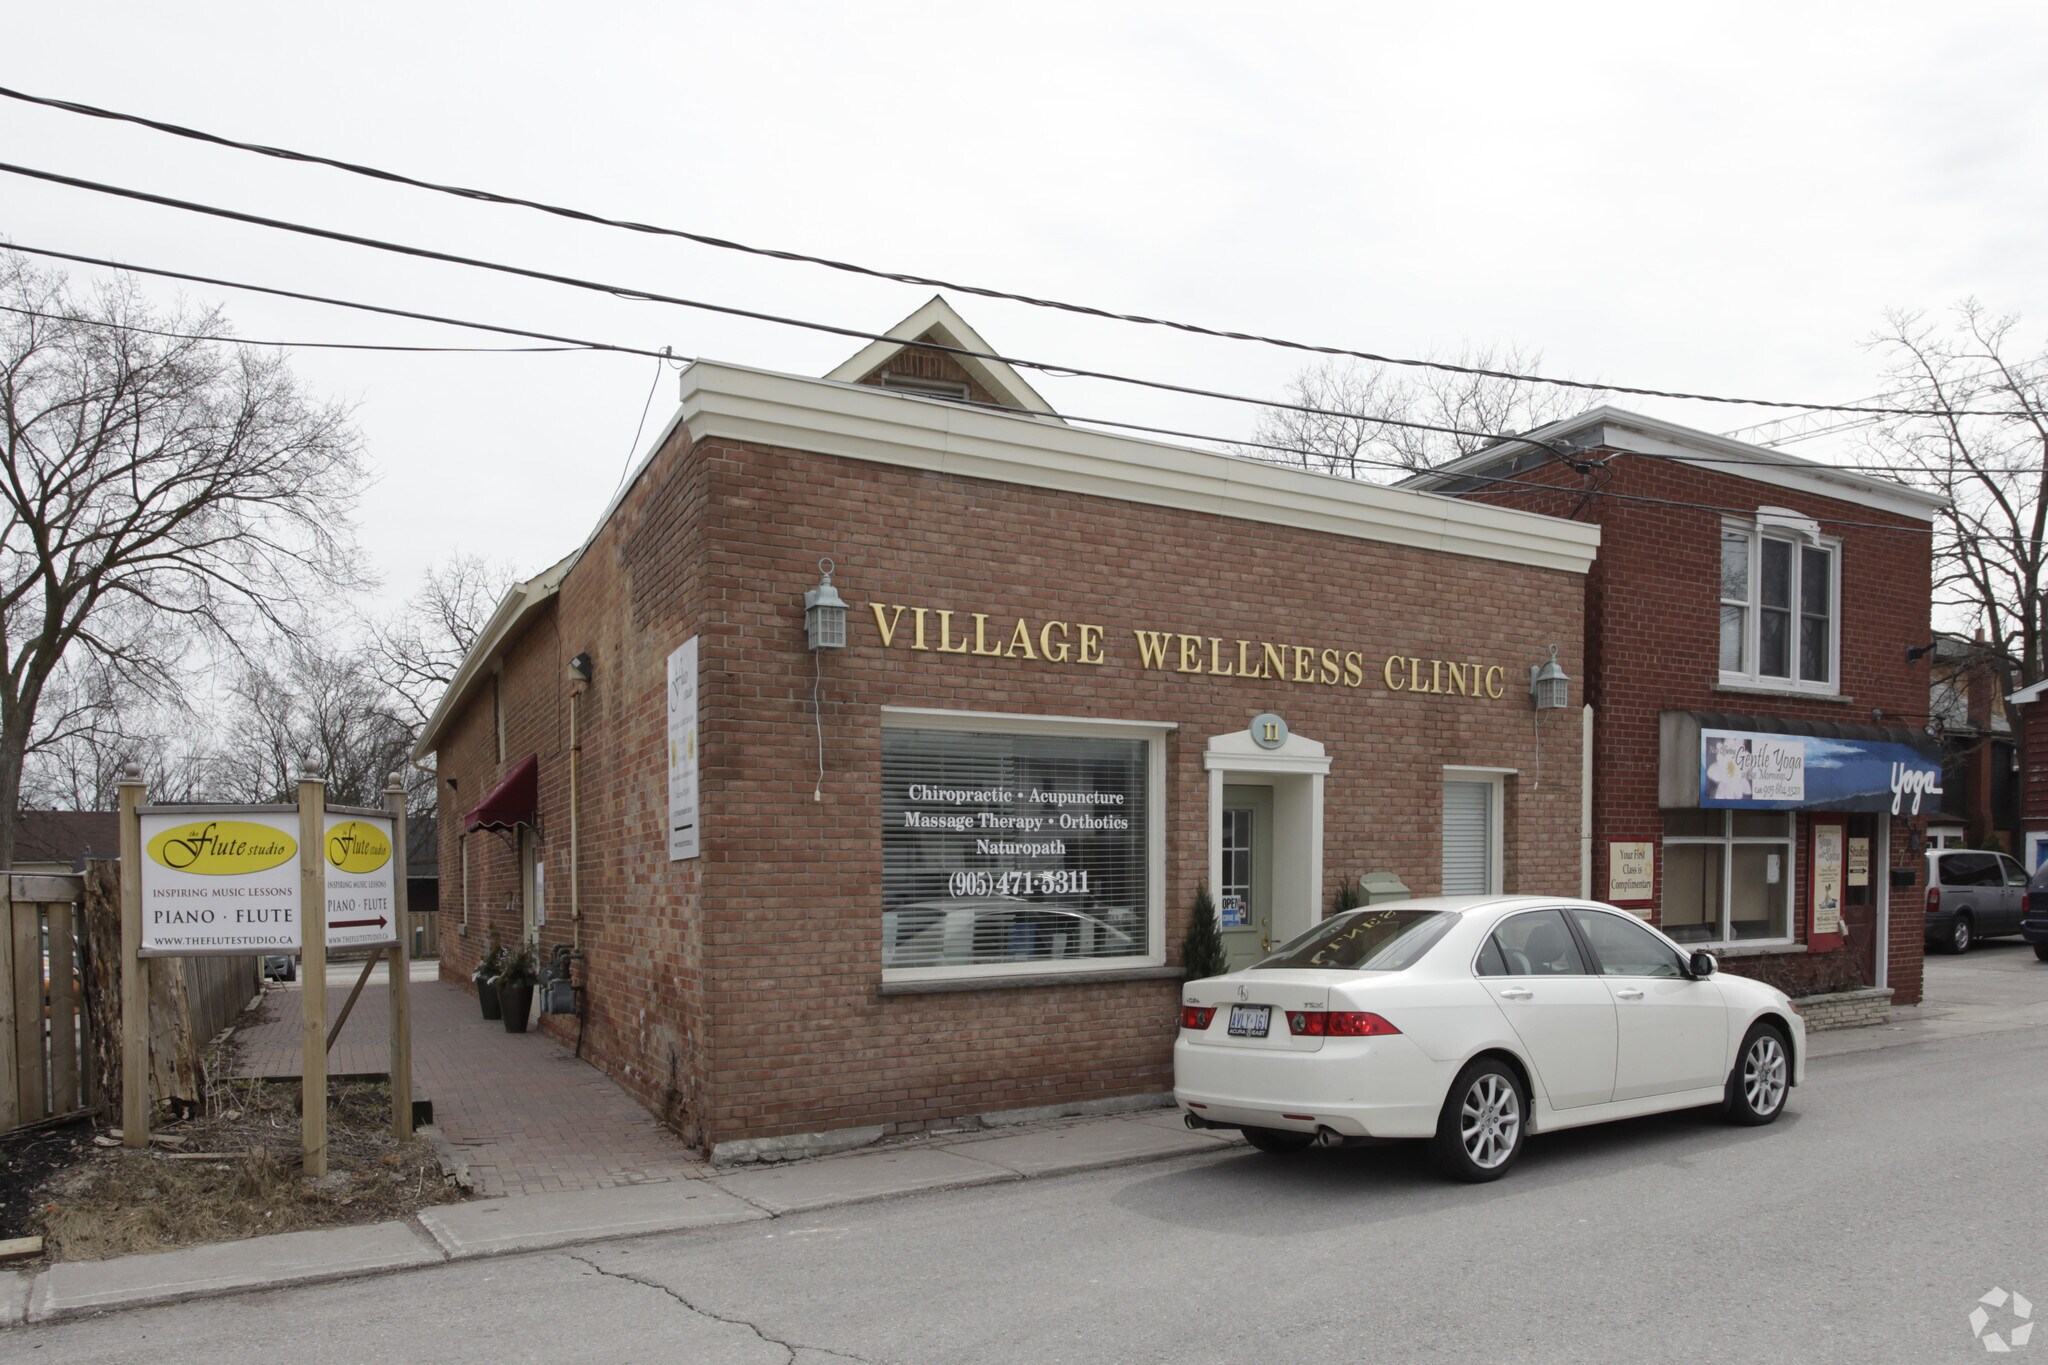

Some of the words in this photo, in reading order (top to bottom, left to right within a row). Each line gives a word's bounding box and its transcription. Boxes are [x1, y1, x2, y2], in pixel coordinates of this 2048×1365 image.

[868, 602, 1105, 665] VILLAGE
[1133, 630, 1363, 687] WELLNESS
[1384, 655, 1505, 699] CLINIC
[1263, 722, 1280, 742] 11
[1735, 743, 1769, 771] Gentle
[1773, 748, 1802, 781] Yoga
[909, 784, 1012, 805] Chiropractic
[1029, 788, 1124, 807] Acupuncture
[904, 812, 974, 831] Massage
[978, 813, 1043, 831] Therapy
[1059, 814, 1128, 829] Orthotics
[247, 842, 285, 856] studio
[976, 839, 1066, 857] Naturopath
[1620, 849, 1633, 860] Your
[1634, 849, 1645, 860] First
[1622, 864, 1637, 875] Class
[327, 881, 352, 889] INSPIRING
[353, 881, 368, 889] MUSIC
[368, 880, 387, 889] LESSONS
[1611, 879, 1651, 892] Complimentary
[153, 888, 208, 898] INSPIRING
[211, 888, 245, 897] MUSIC
[248, 888, 292, 897] LESSONS
[328, 898, 356, 912] PIANO
[363, 898, 387, 911] FLUTE
[154, 910, 215, 925] PIANO
[236, 909, 293, 923] FLUTE
[154, 936, 293, 946] WWW.THEFLUTESTUDIO.CA
